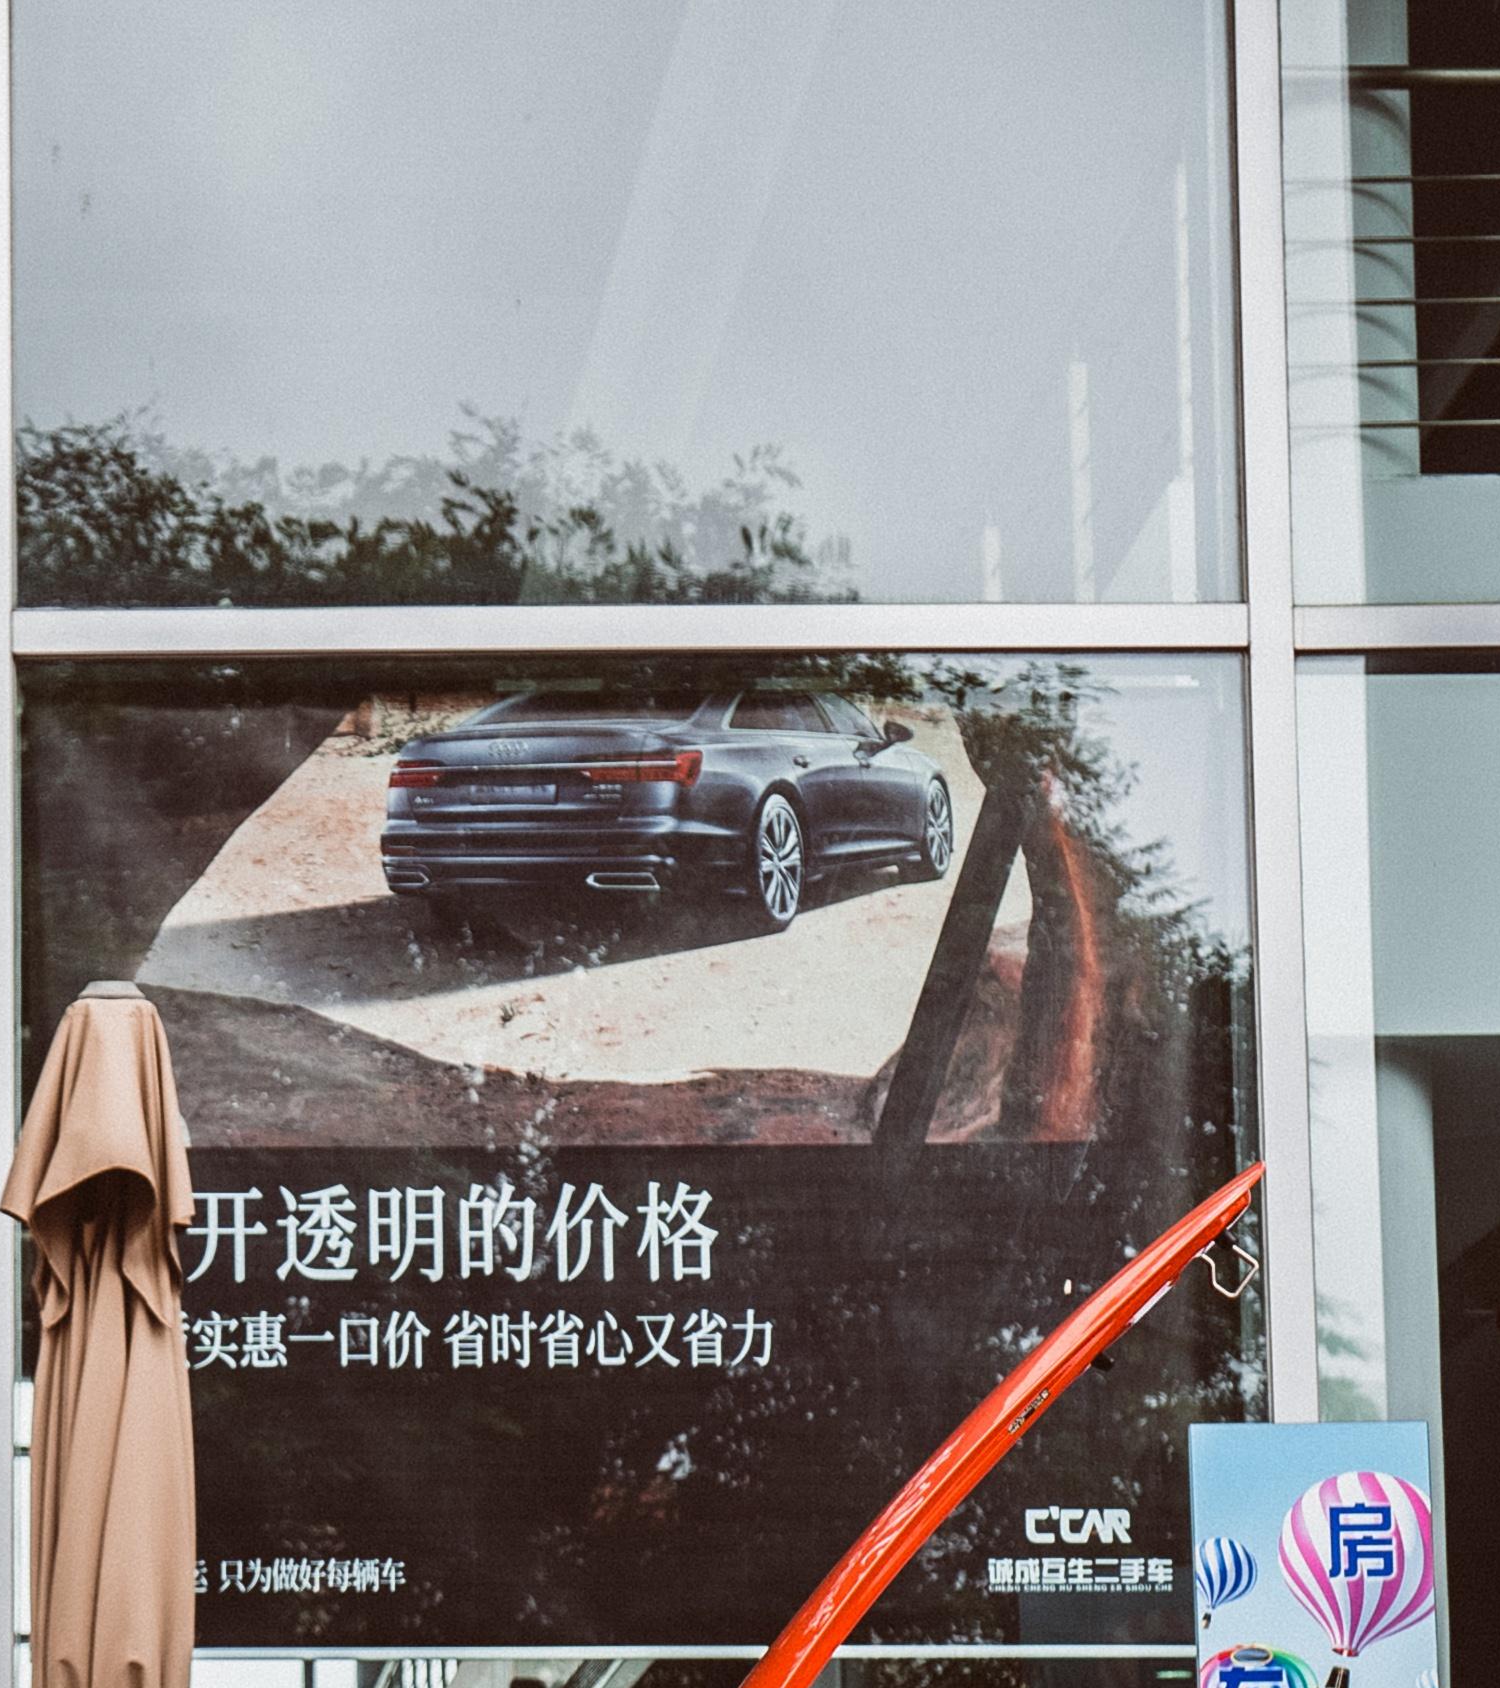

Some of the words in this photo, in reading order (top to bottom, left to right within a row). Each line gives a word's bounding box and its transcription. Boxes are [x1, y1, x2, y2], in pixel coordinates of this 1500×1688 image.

[185, 1180, 721, 1284] 开透明的价格
[180, 1308, 431, 1370] 实惠一口价
[442, 1308, 776, 1370] 省时省心又省力
[219, 1557, 407, 1593] 只为做好每辆车
[987, 1557, 1174, 1585] 诚成互生二手车
